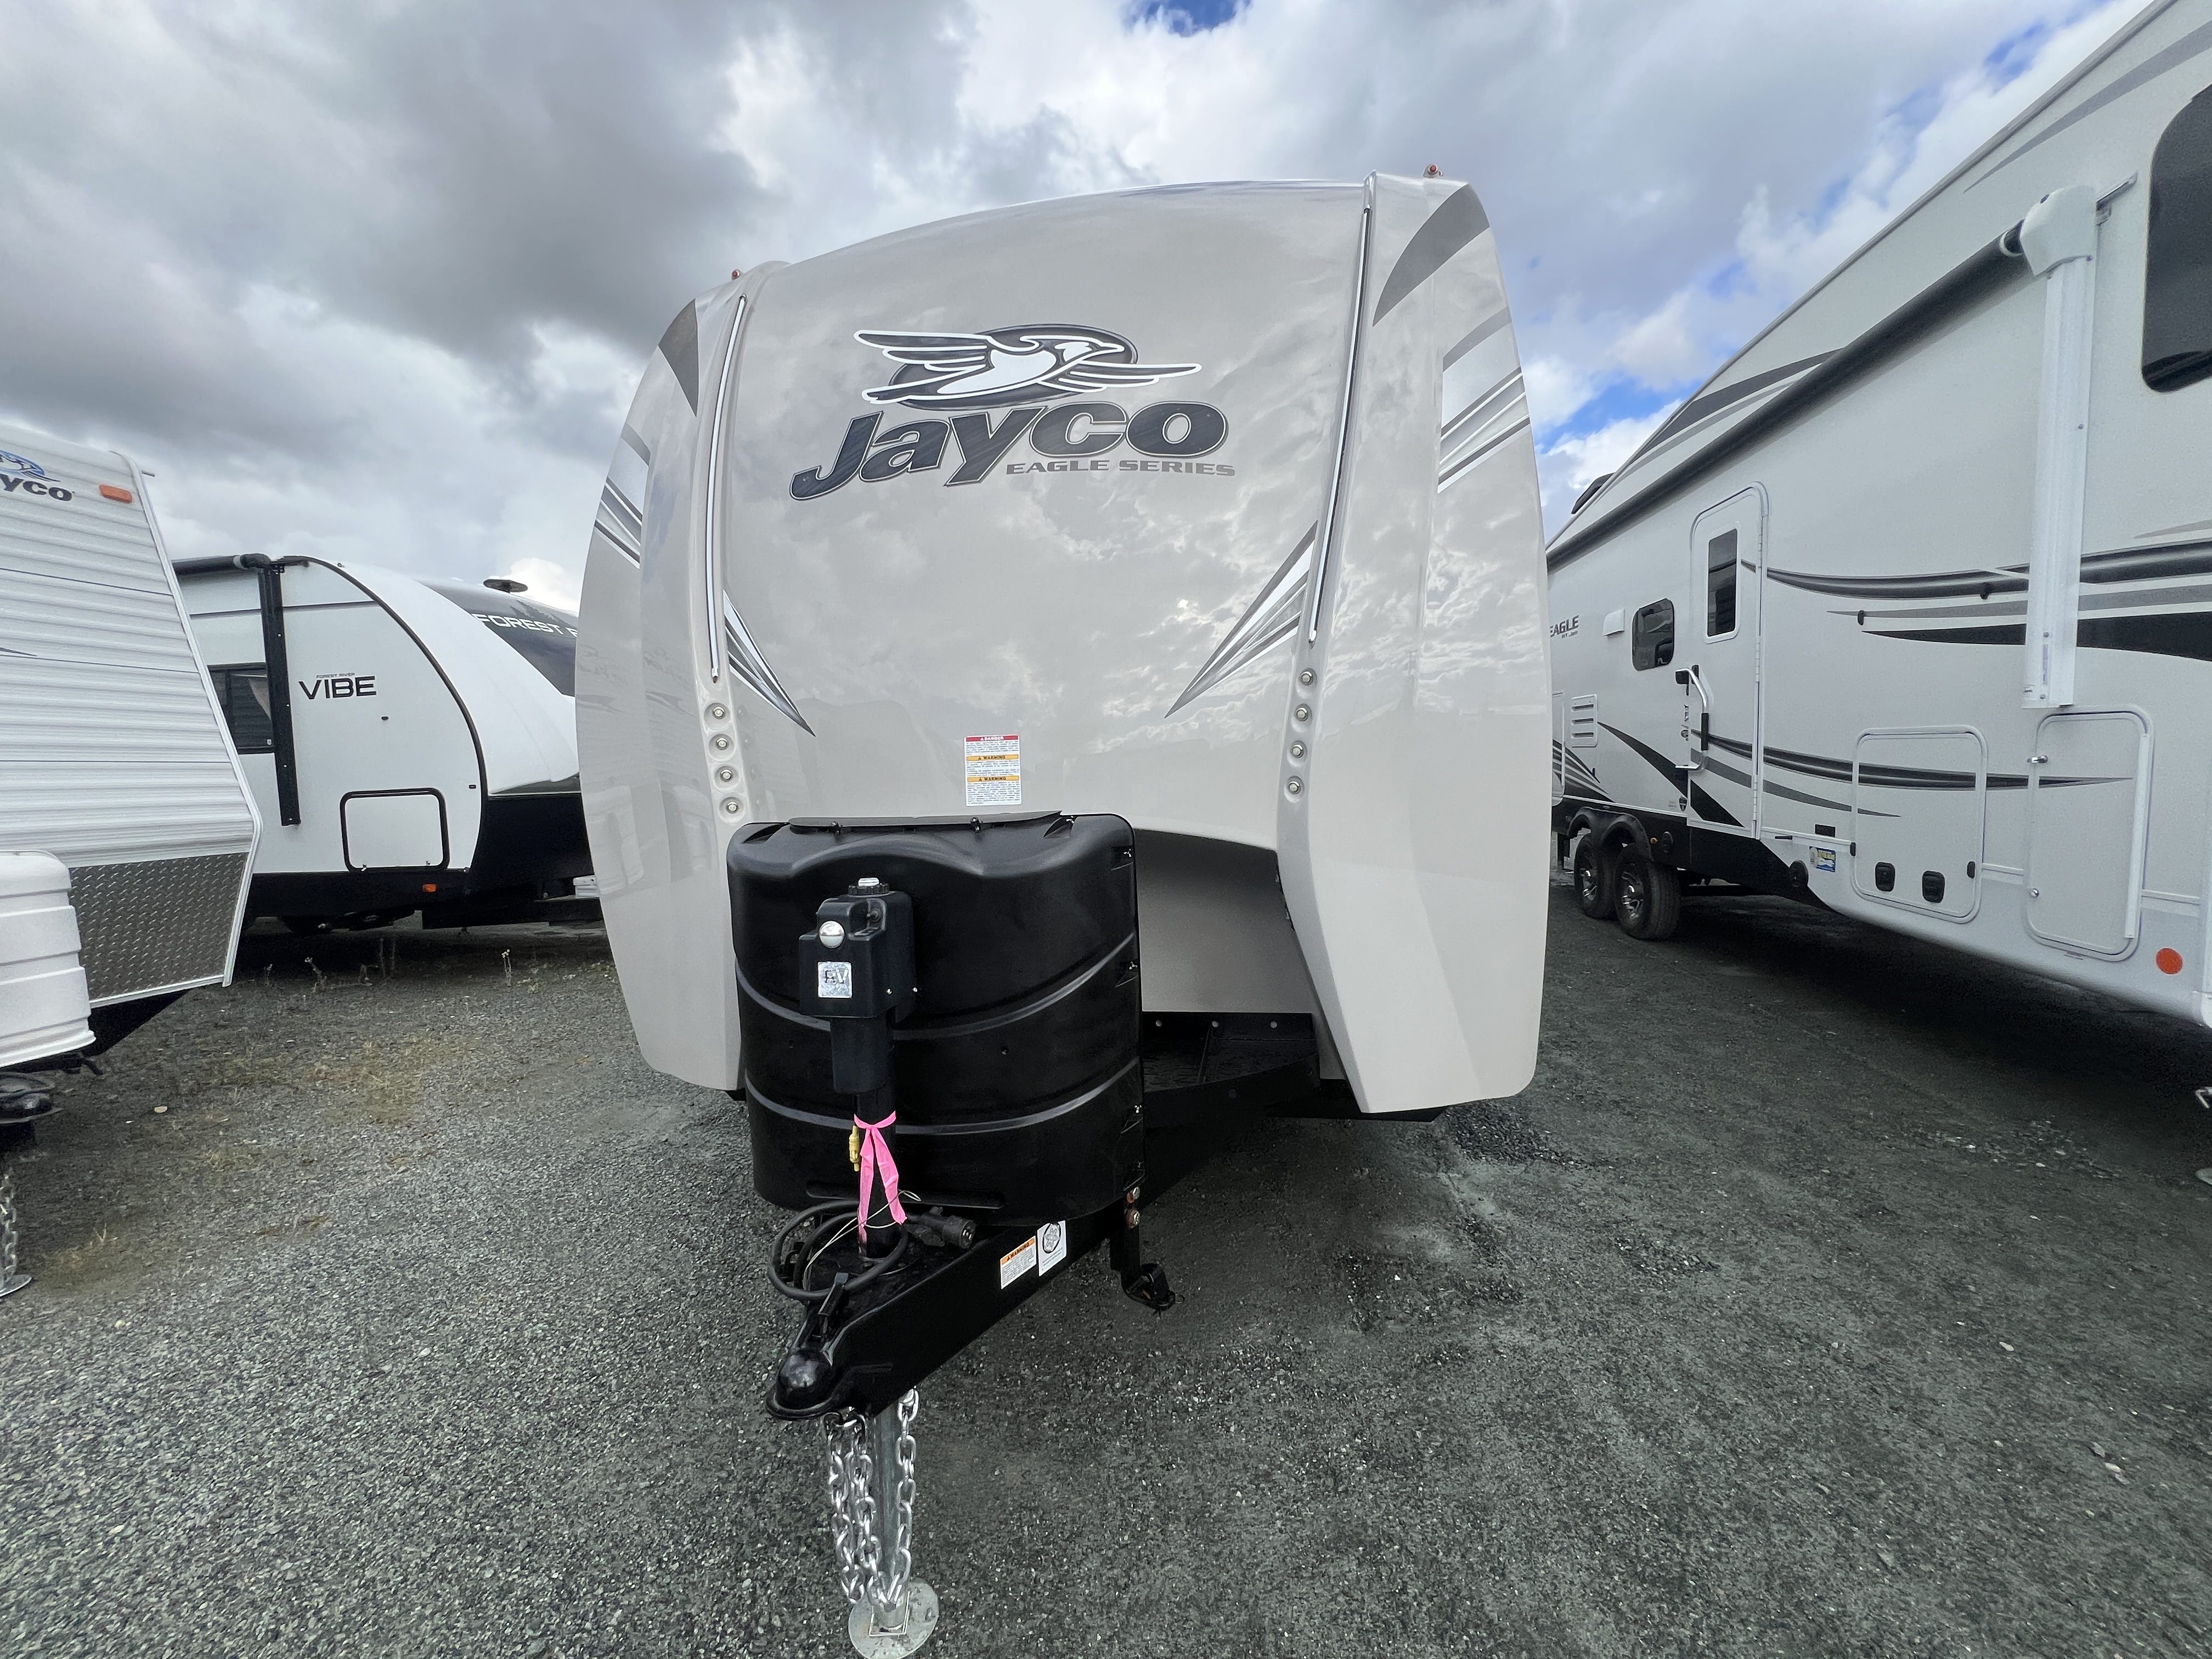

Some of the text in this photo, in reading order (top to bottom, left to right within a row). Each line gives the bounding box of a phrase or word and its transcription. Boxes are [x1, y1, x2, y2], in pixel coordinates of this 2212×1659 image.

[788, 400, 1228, 501] Jayco
[1006, 460, 1235, 477] EAGLE SERIES
[0, 473, 72, 501] yco
[471, 613, 564, 635] FOREST
[298, 675, 377, 700] VIBE
[1009, 1242, 1030, 1259] WARNING
